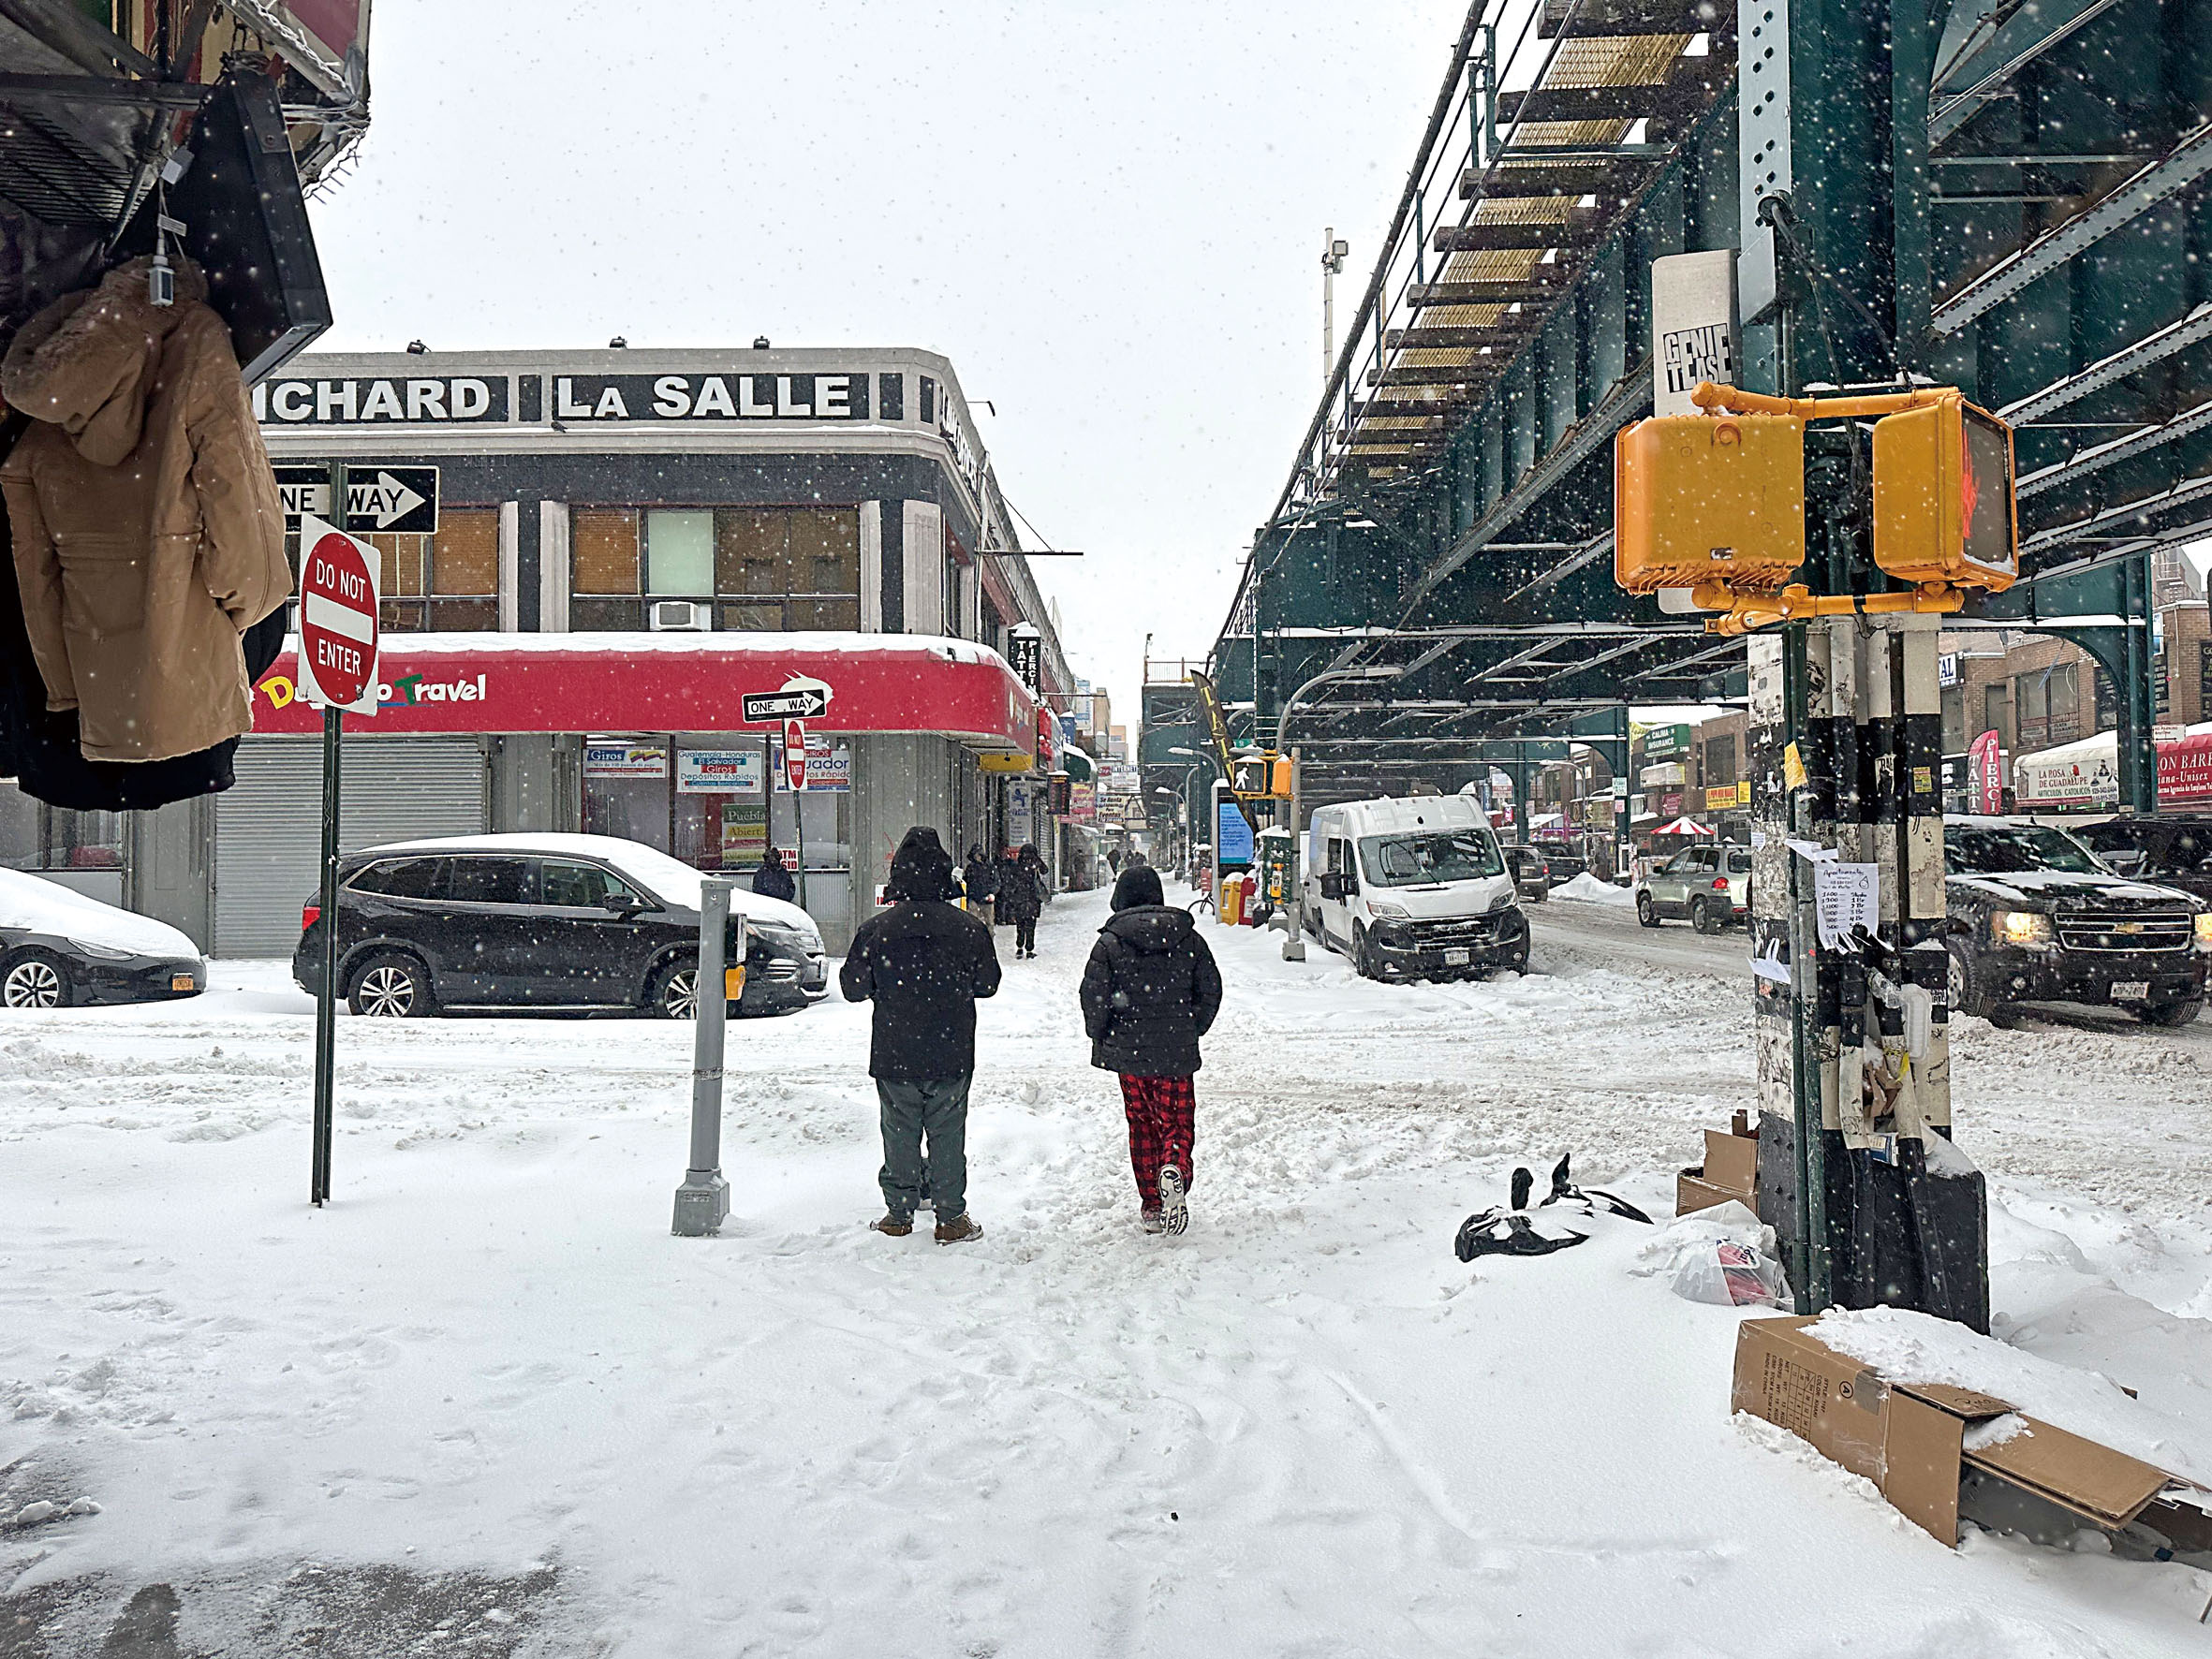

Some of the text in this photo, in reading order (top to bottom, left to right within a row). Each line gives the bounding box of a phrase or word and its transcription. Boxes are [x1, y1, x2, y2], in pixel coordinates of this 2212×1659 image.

[253, 378, 490, 421] ICHARD
[654, 376, 850, 417] SALLE
[281, 488, 405, 513] NE WAY
[317, 559, 366, 603] DO NOT
[318, 638, 361, 676] ENTER
[1939, 658, 1954, 679] AL
[394, 674, 486, 705] Travel
[751, 698, 814, 712] ONE WAY
[1648, 737, 1674, 750] INSURANCE
[591, 751, 622, 760] Giros
[707, 765, 732, 773] Giros
[806, 758, 848, 770] uador
[2158, 756, 2177, 771] ON
[2039, 769, 2066, 779] LA ROSA
[2039, 776, 2088, 788] DE GUADALUPE
[2038, 786, 2091, 798] ARTICULOS CATOLICOS
[729, 811, 766, 821] Puebla
[730, 828, 765, 837] Abiert
[1763, 1369, 1769, 1377] IN
[1842, 1385, 1851, 1394] A
